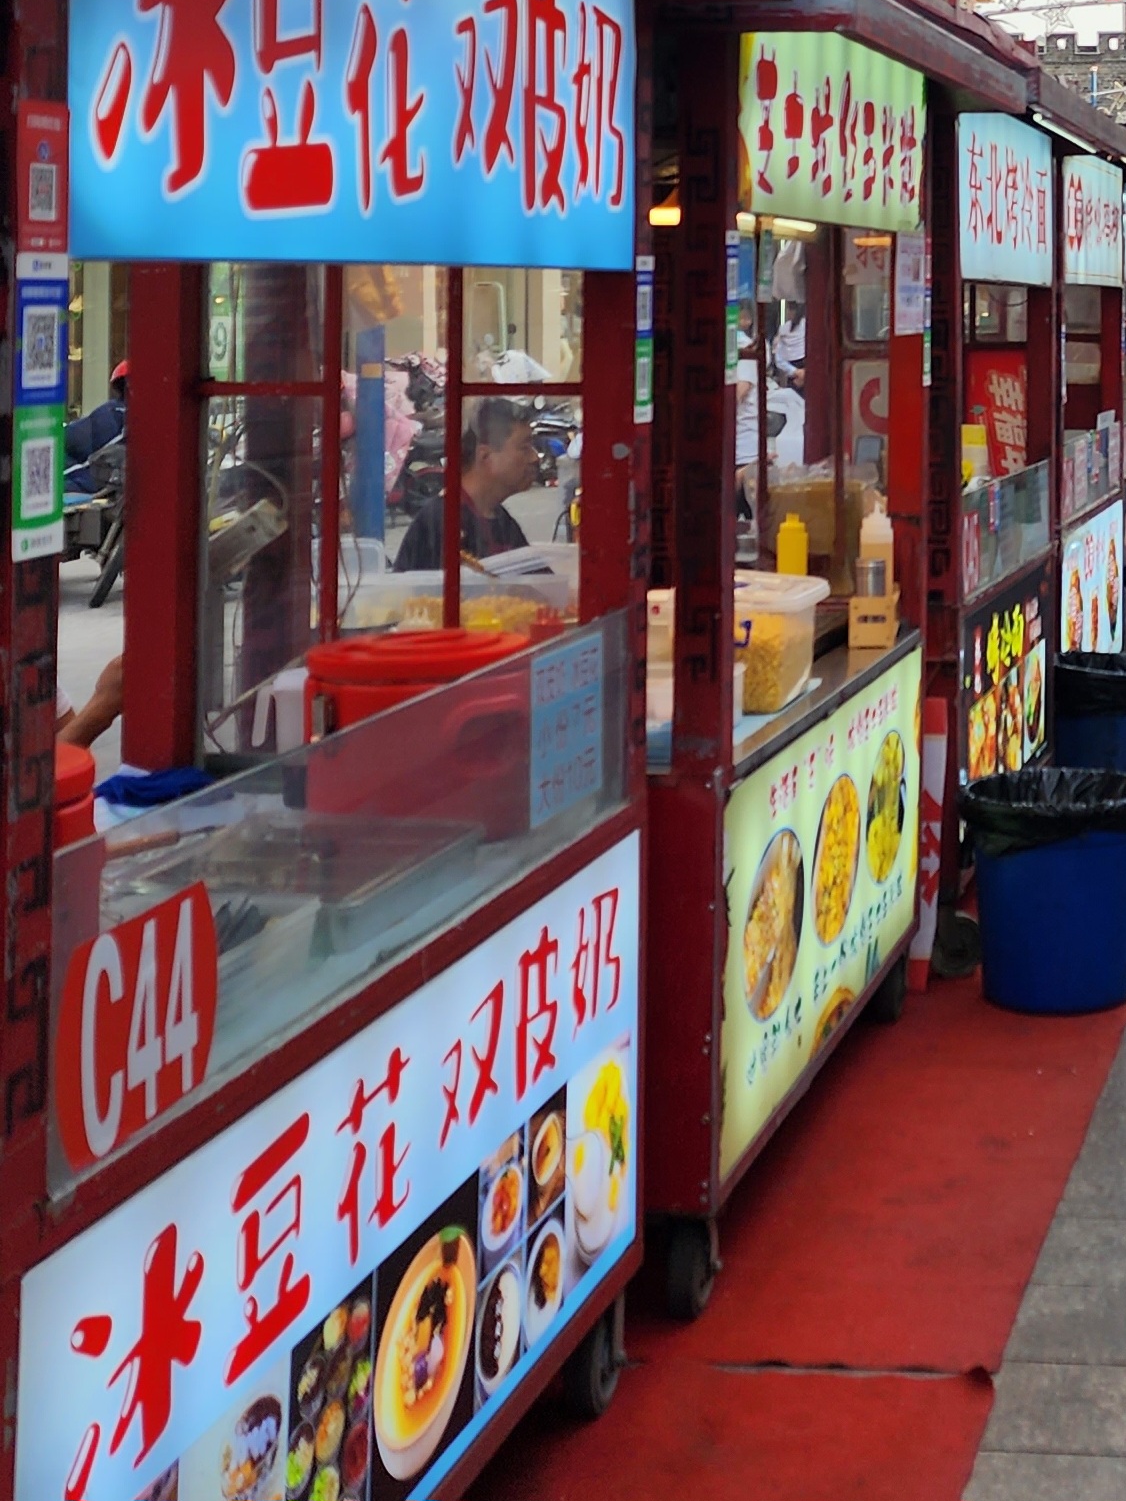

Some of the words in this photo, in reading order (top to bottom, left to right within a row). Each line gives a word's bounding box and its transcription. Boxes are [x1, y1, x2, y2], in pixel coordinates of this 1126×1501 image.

[967, 132, 1048, 254] 东北烤冷面
[81, 898, 198, 1159] C44
[64, 1048, 412, 1501] 冰豆花
[440, 887, 622, 1151] 双皮奶
